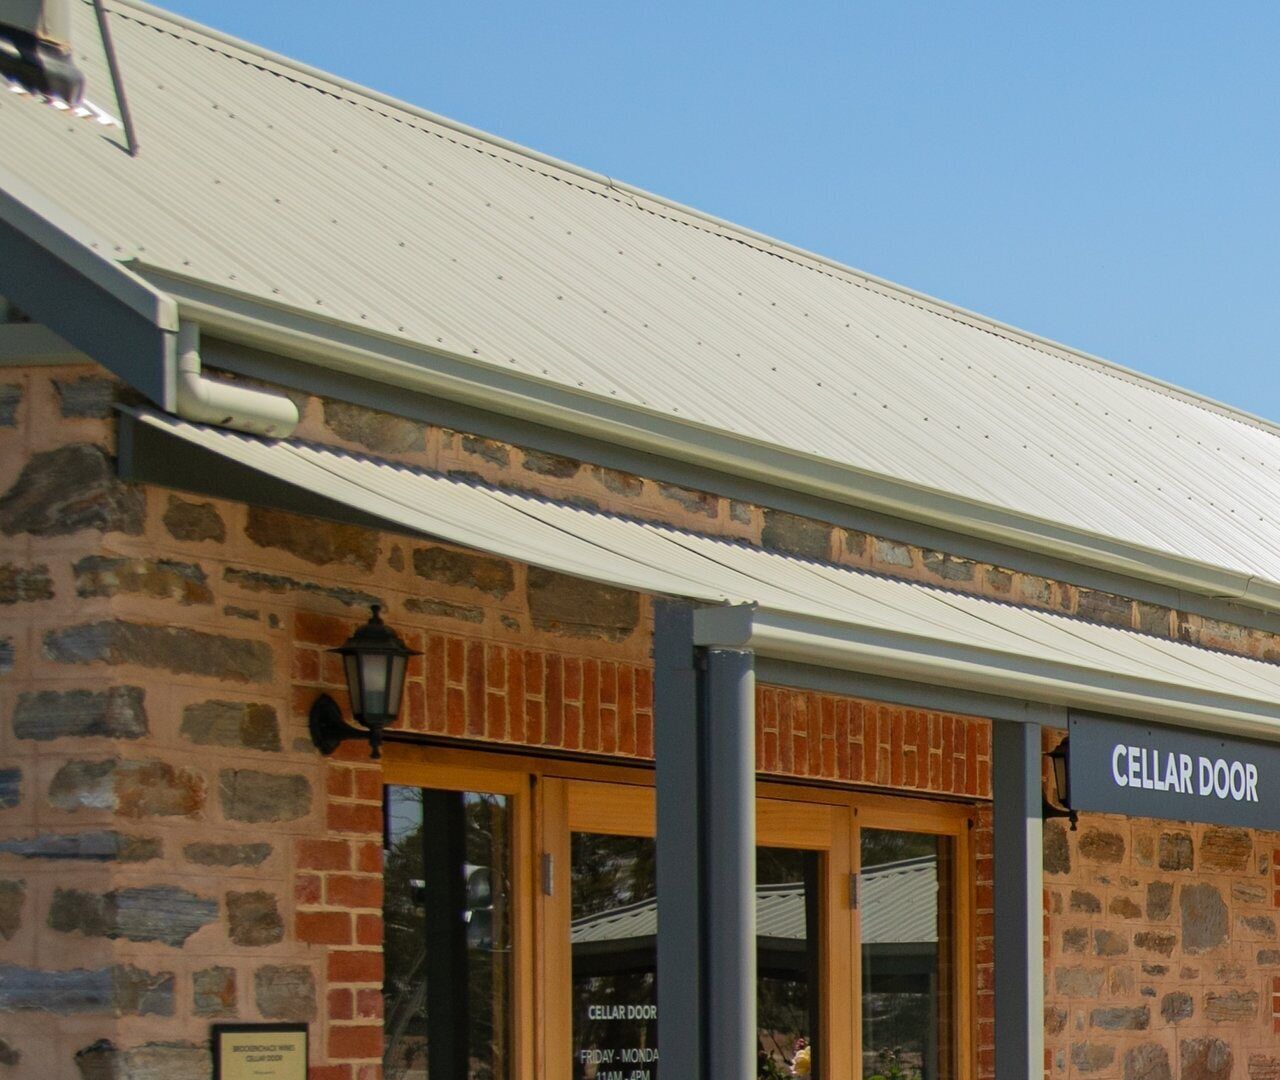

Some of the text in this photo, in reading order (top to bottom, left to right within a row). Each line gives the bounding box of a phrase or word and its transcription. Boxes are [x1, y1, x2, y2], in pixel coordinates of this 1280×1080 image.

[1112, 744, 1259, 802] CELLAR DOOR
[588, 1005, 657, 1020] CELLAR DOOR
[580, 1049, 615, 1064] FRIDAY
[622, 1048, 659, 1063] MONDA
